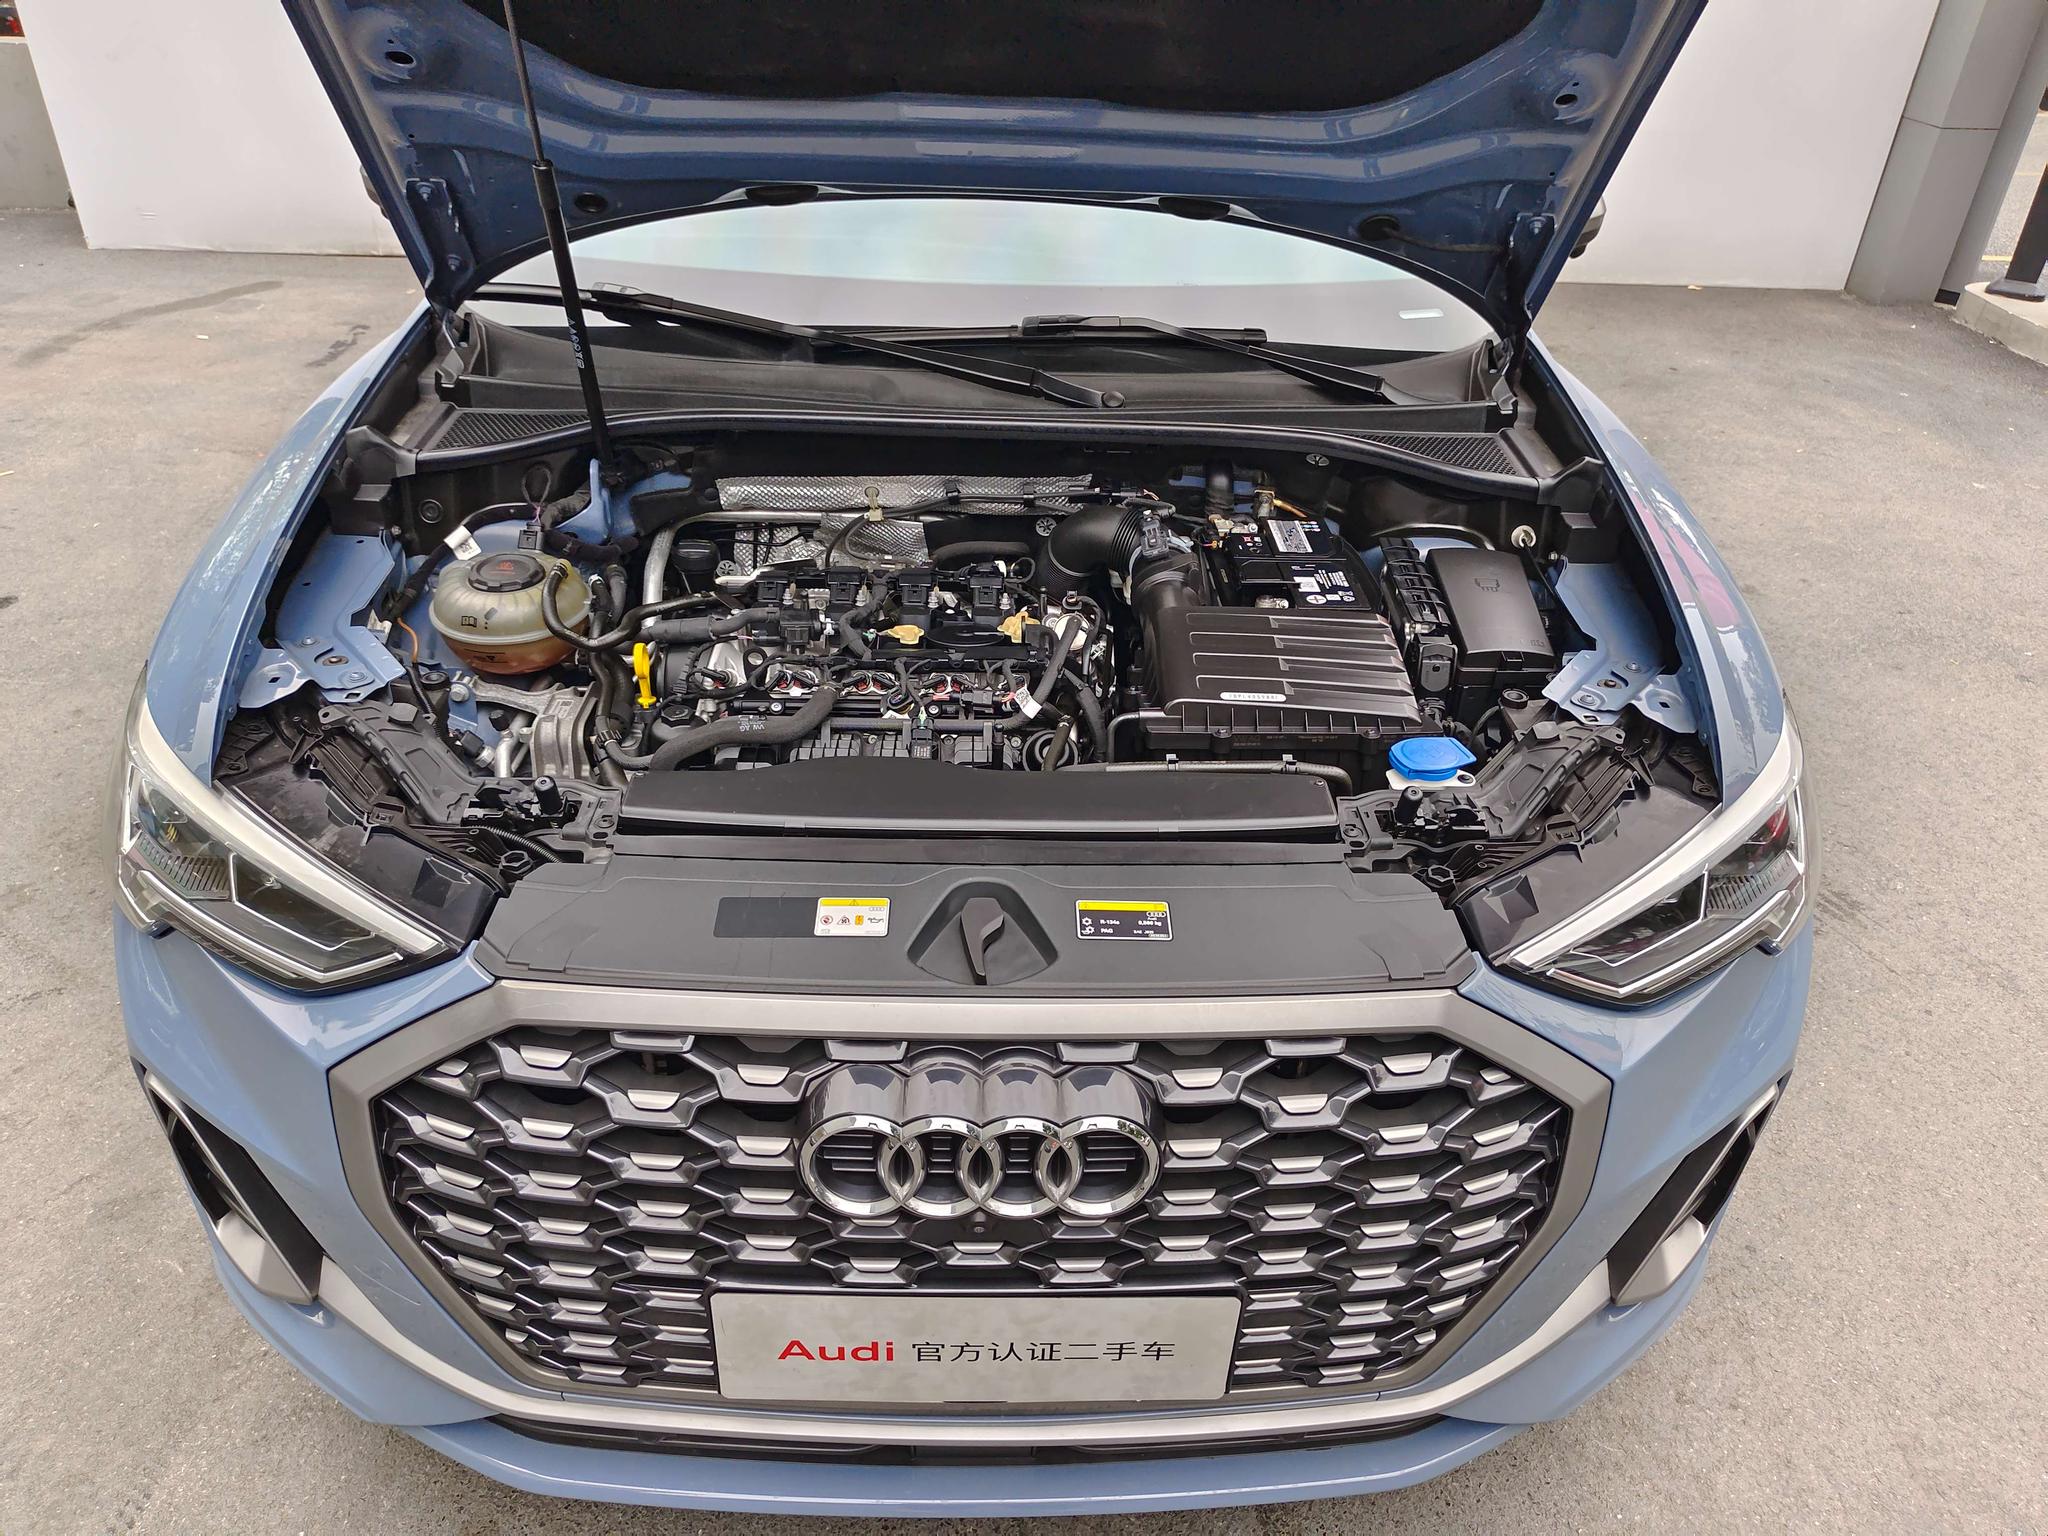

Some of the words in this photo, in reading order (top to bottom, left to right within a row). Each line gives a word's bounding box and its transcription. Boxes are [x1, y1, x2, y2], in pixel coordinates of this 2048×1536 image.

[778, 1340, 894, 1361] Audi
[911, 1341, 1176, 1362] 官方认证二手车
